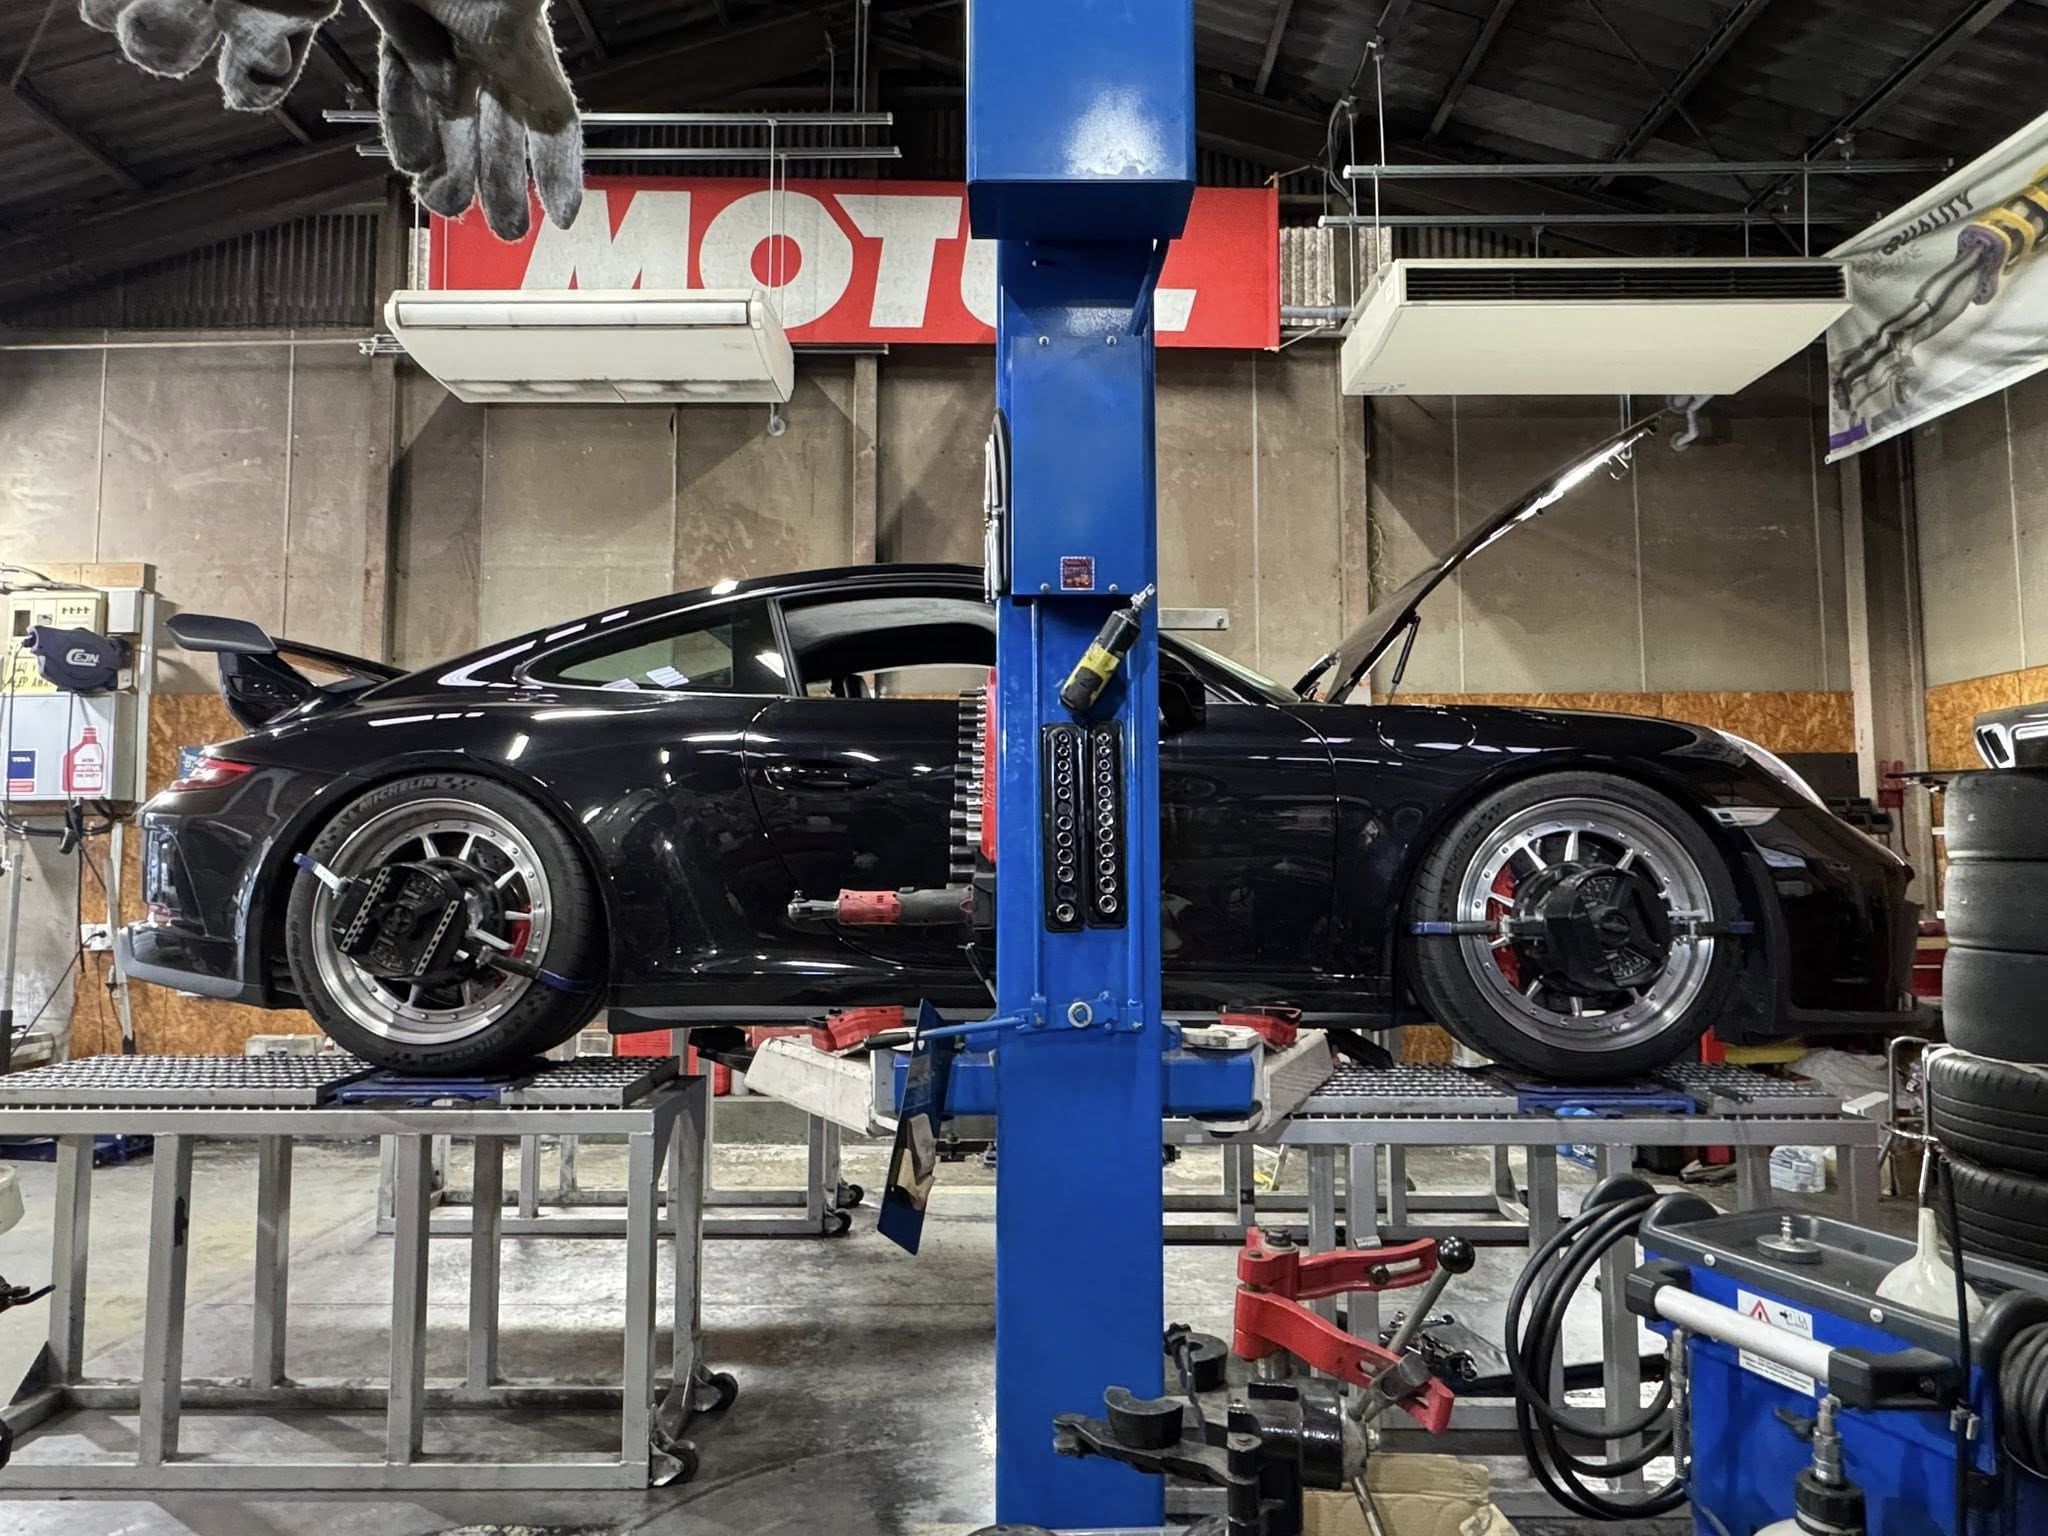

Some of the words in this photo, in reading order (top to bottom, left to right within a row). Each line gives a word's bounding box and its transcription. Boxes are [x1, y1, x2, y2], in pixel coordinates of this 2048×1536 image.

[1881, 189, 1974, 255] QUALITY
[522, 190, 1197, 332] MOT
[66, 648, 100, 667] CEJN
[358, 778, 438, 812] MICHELIN
